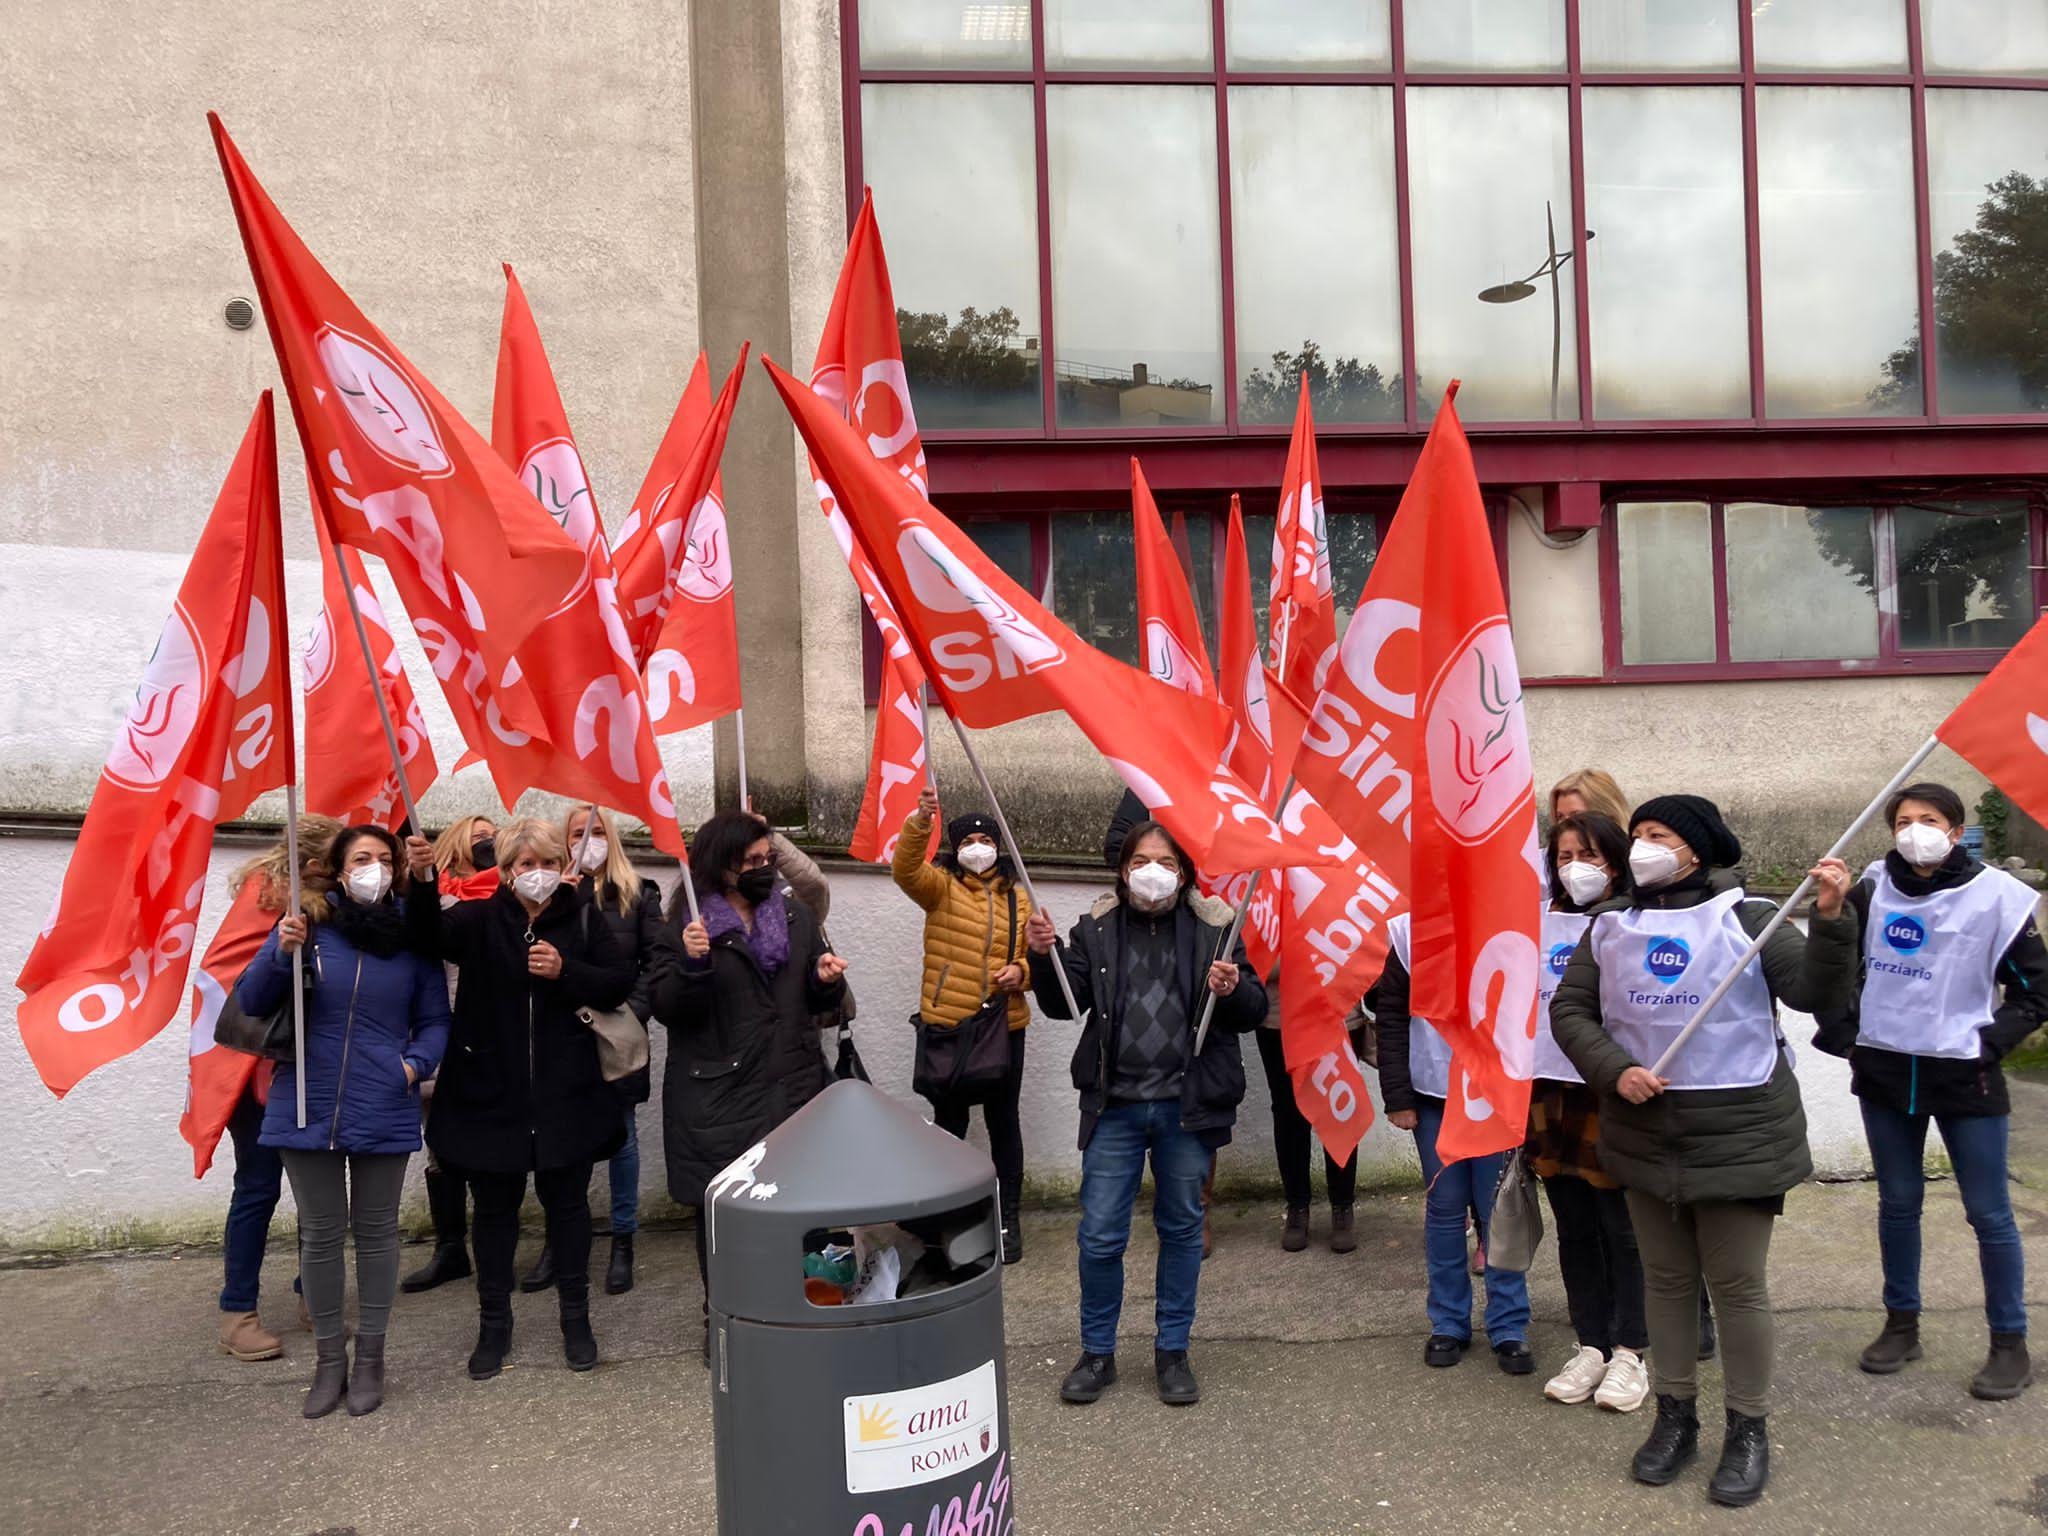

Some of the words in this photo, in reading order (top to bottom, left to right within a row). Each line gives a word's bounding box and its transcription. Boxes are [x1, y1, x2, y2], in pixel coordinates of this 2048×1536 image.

[1302, 689, 1413, 842] sin
[1887, 925, 1921, 942] UGL
[1651, 952, 1686, 967] UGL
[1867, 957, 1933, 981] Terziario
[1628, 990, 1700, 1006] Terziario
[907, 1398, 969, 1436] ama
[911, 1441, 970, 1474] ROMA
